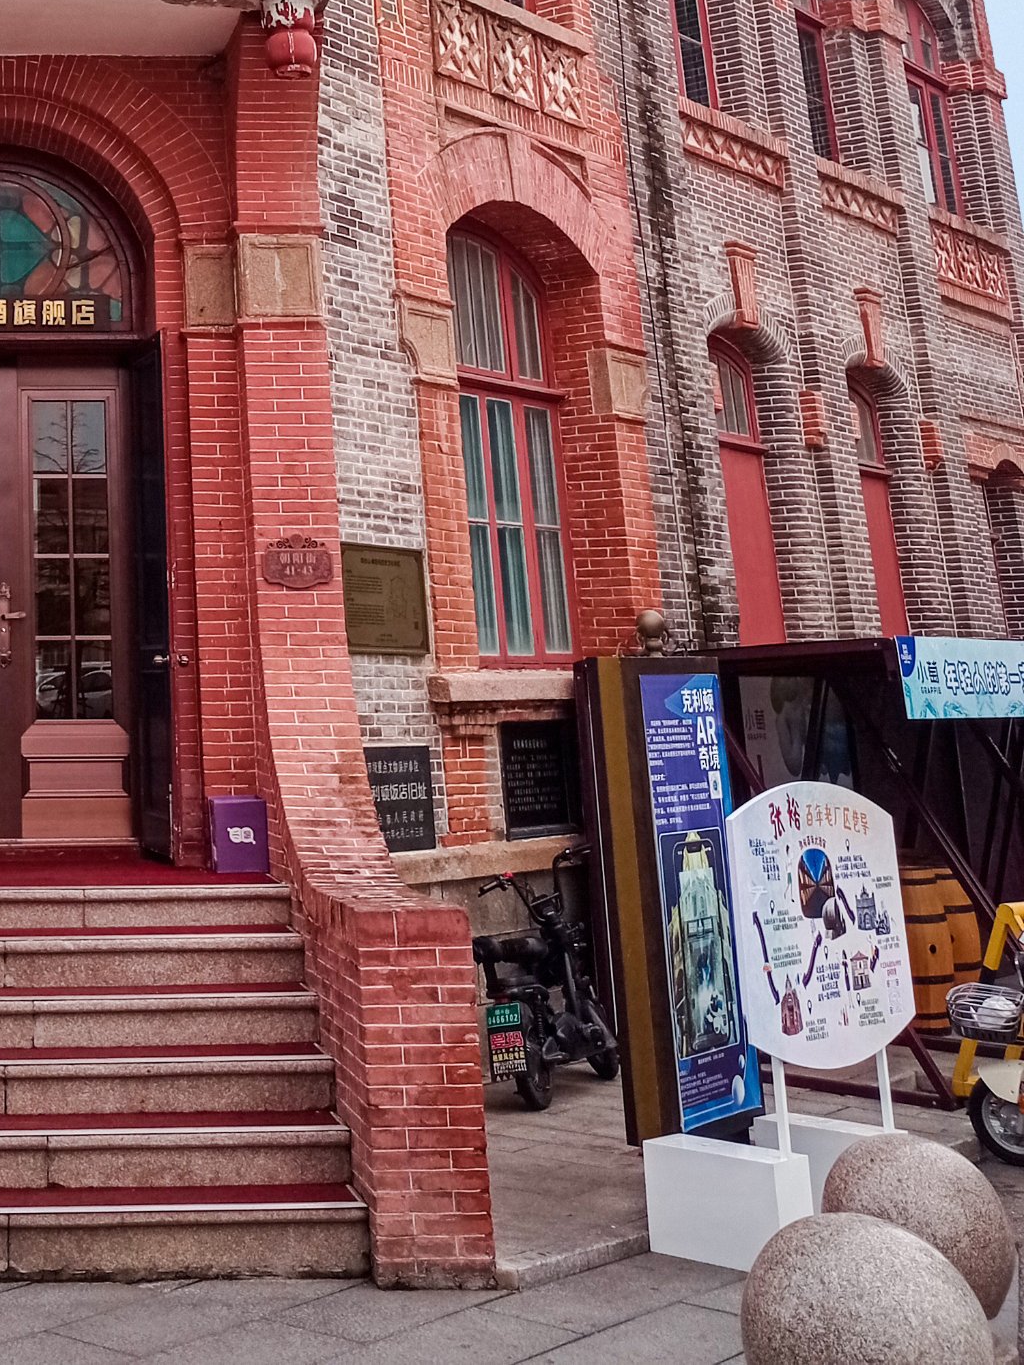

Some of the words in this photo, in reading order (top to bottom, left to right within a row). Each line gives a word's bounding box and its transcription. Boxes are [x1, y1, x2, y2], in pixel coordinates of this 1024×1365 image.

[279, 552, 316, 564] 朝阳街
[284, 565, 313, 576] 41-43
[681, 688, 715, 713] 克利顿
[696, 716, 718, 745] AR
[698, 744, 721, 771] 奇境
[769, 793, 801, 840] 张裕
